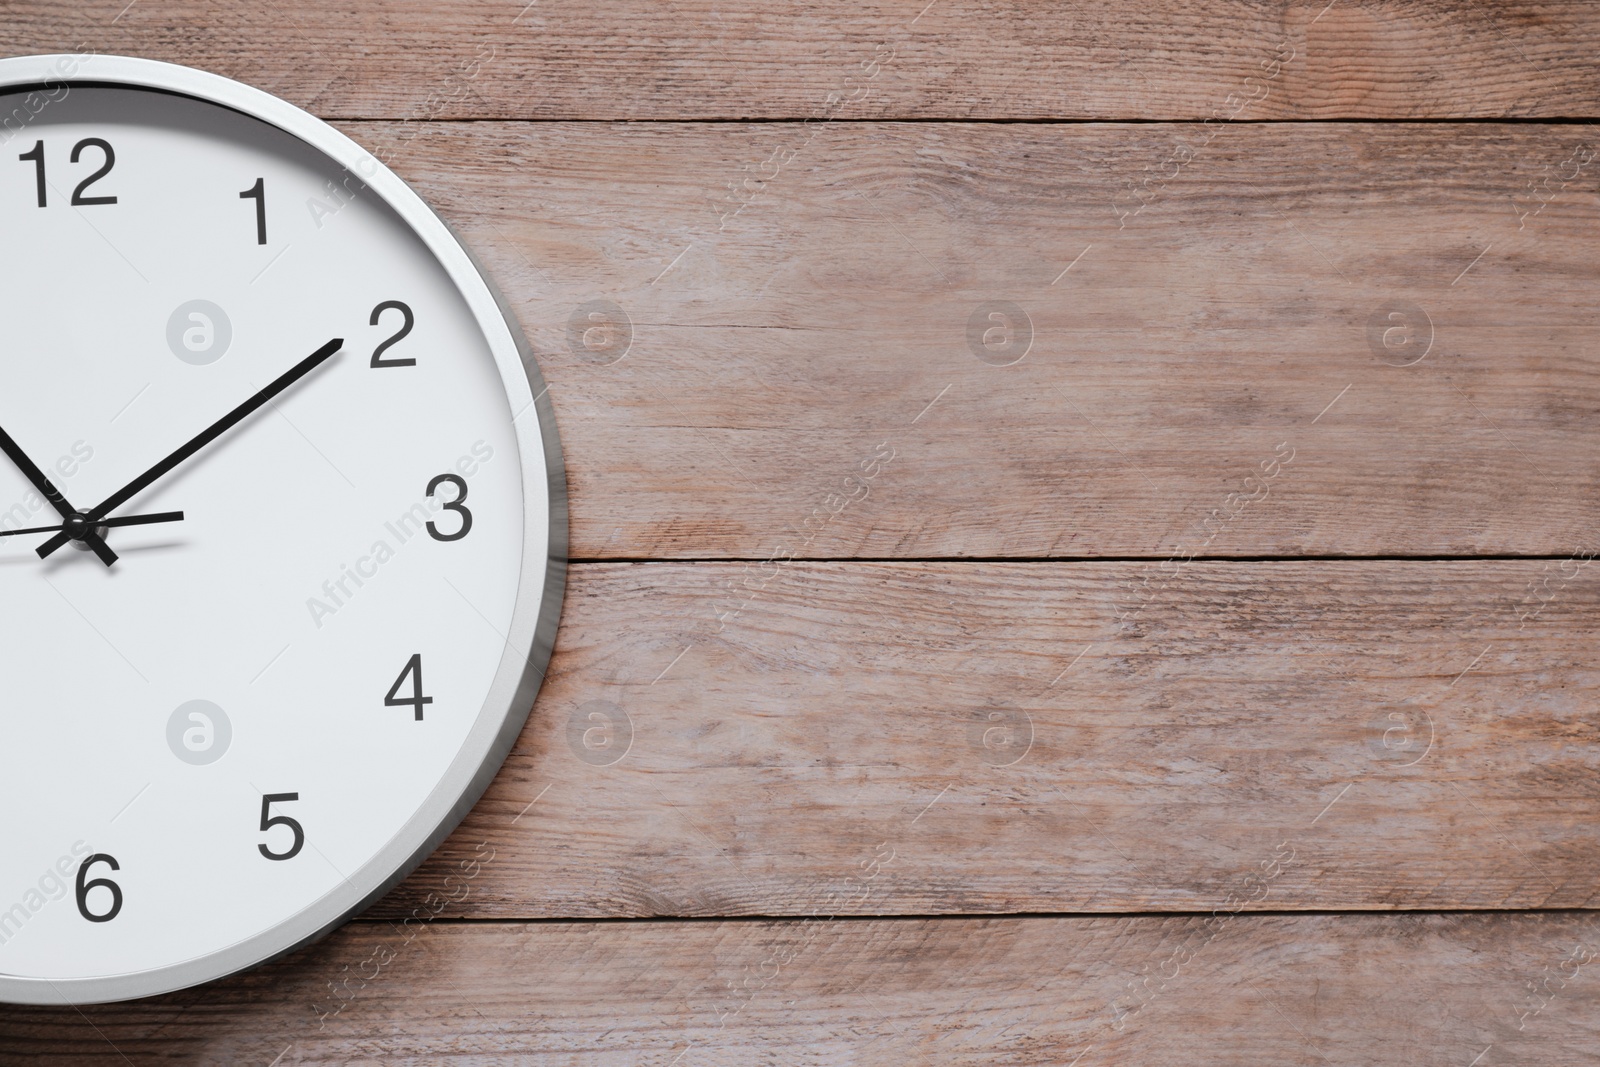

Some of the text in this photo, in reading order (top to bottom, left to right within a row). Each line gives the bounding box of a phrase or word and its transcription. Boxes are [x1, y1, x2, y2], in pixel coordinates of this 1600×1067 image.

[19, 138, 117, 207] 12
[240, 178, 266, 245] 1
[370, 301, 416, 368] 2
[426, 474, 473, 541] 3
[385, 654, 432, 720] 4
[258, 793, 305, 860] 5
[76, 854, 123, 922] 6
